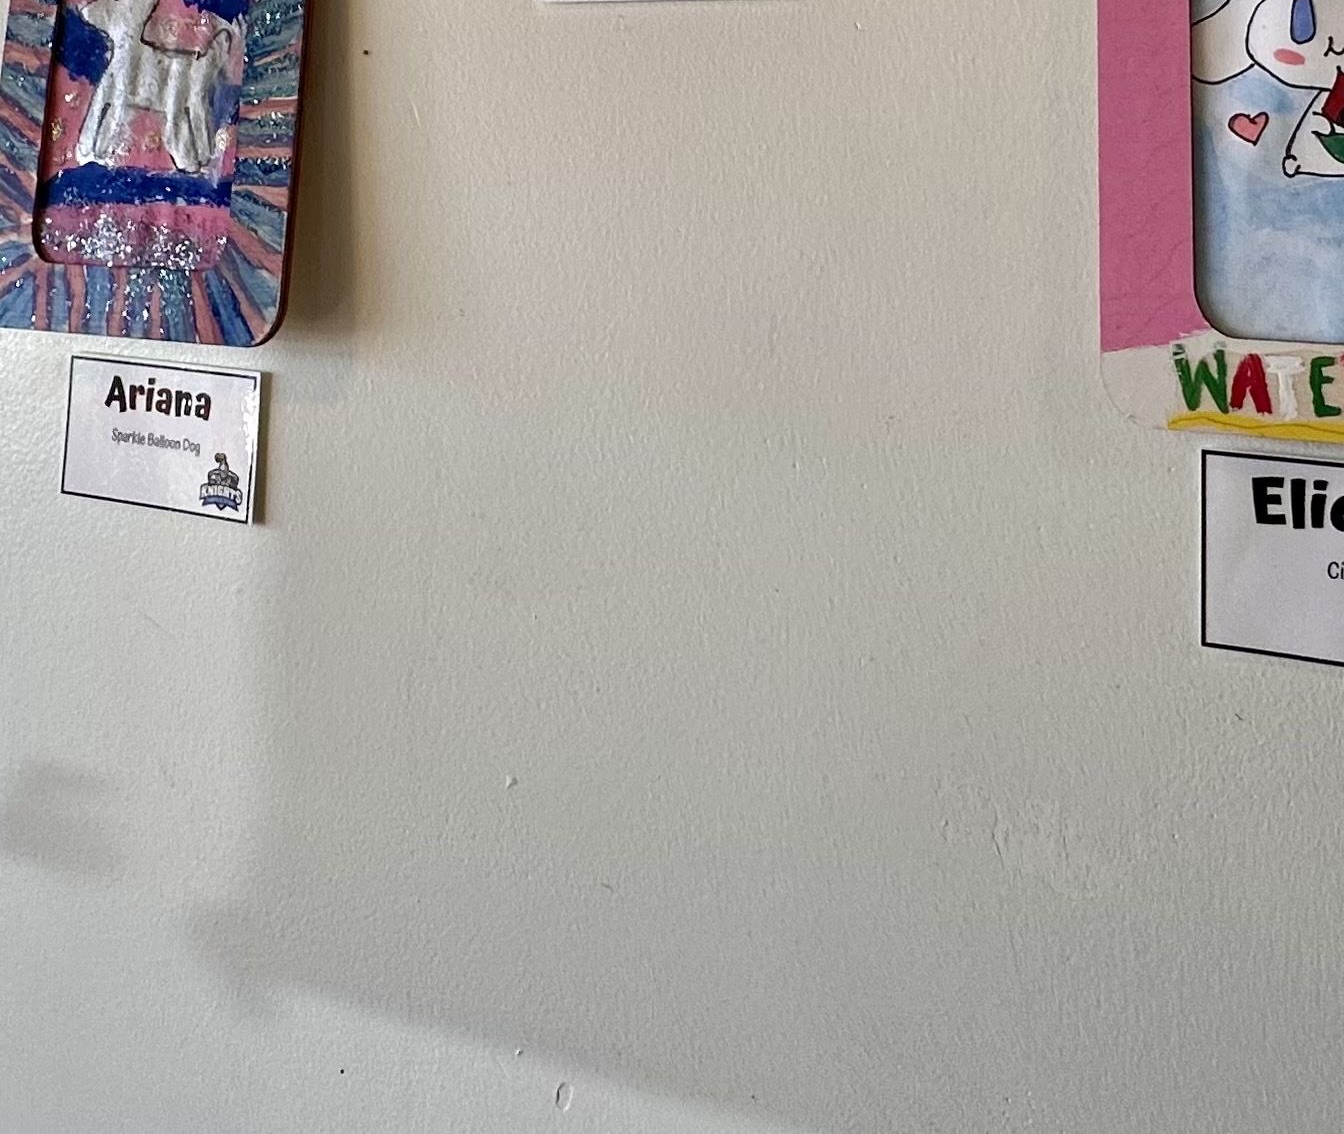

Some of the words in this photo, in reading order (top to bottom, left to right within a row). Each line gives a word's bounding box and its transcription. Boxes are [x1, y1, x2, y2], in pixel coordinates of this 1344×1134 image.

[104, 375, 212, 421] Ariana
[111, 427, 146, 446] Sparkle
[147, 433, 181, 449] Balloon
[183, 438, 201, 456] Dog
[201, 483, 243, 506] KNIGHTS
